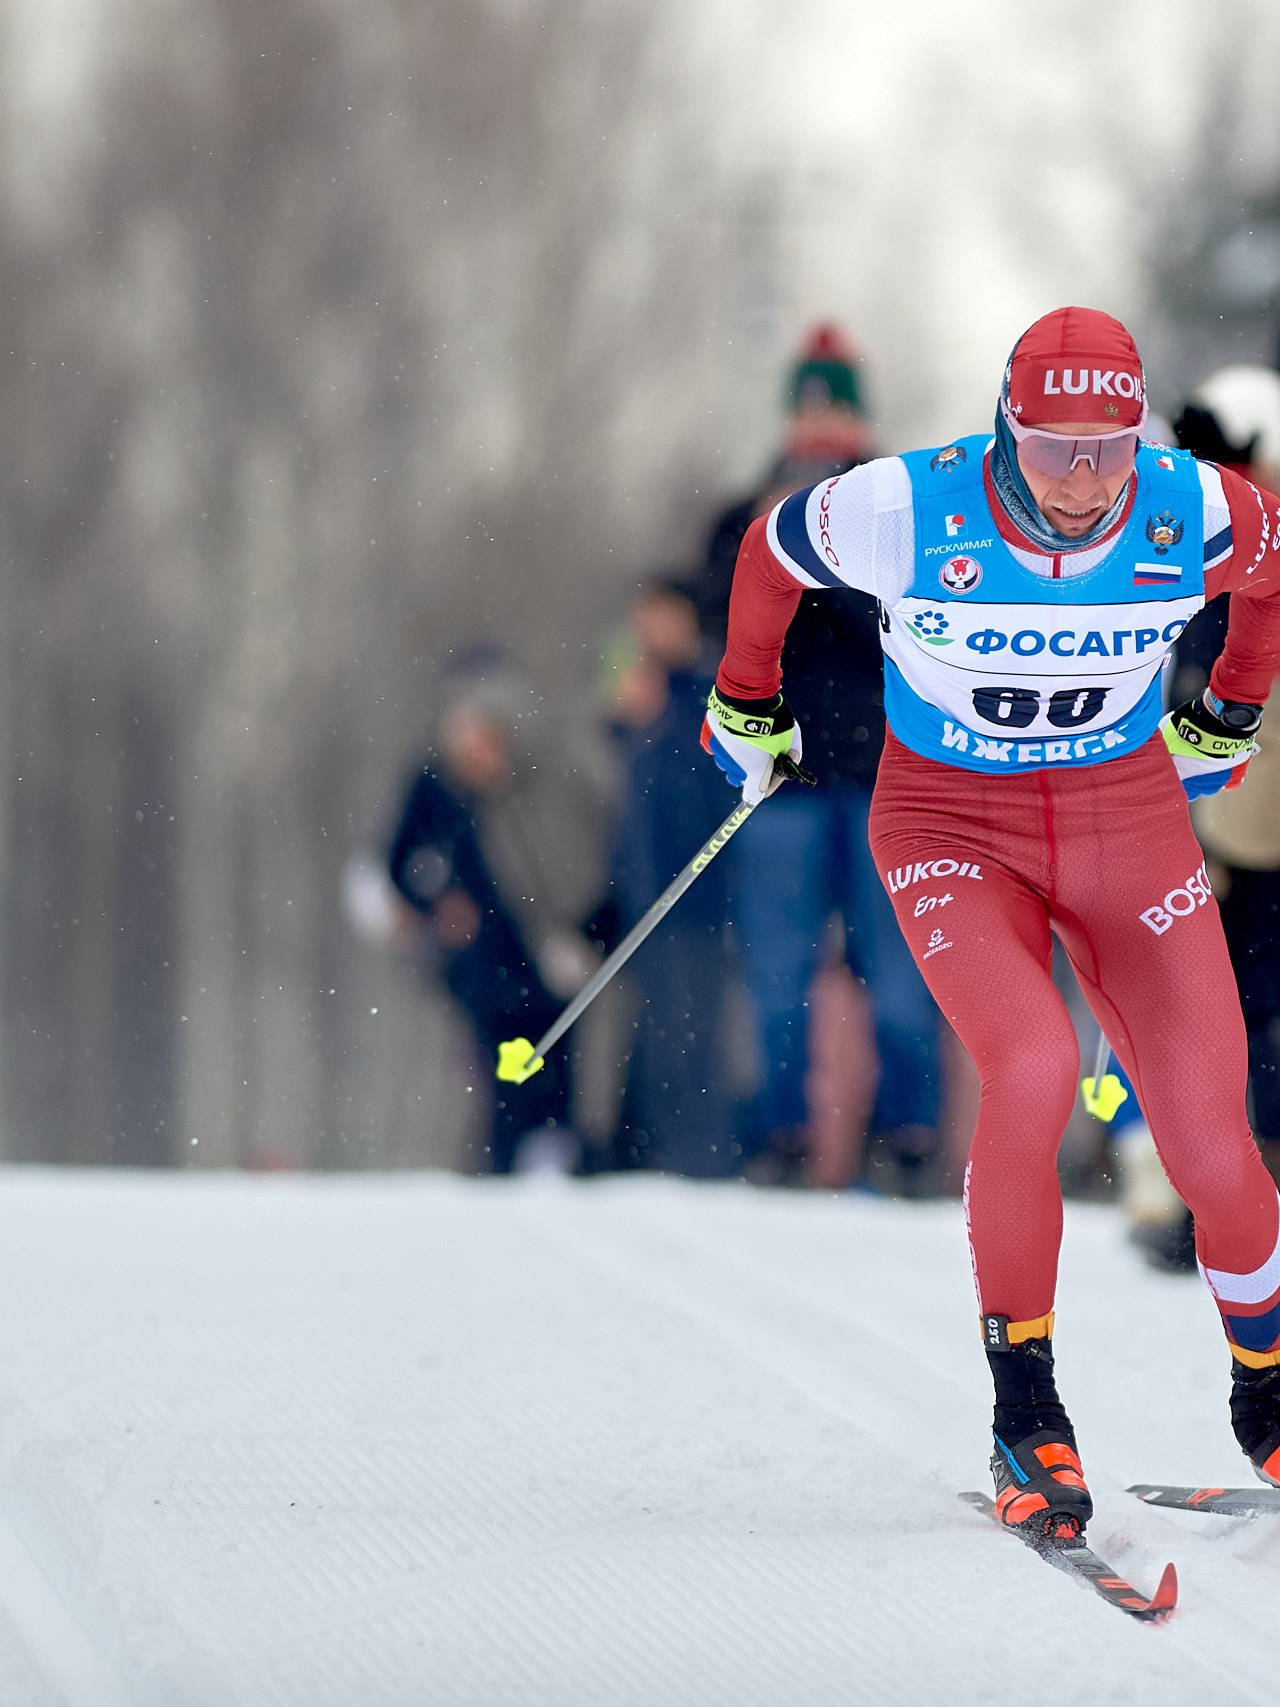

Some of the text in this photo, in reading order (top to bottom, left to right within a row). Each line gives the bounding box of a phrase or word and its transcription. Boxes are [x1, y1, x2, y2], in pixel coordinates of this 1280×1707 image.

[925, 538, 994, 557] РУСКЛИМАТ
[965, 619, 1189, 657] ФОСАГРО
[887, 858, 984, 895] LUKOIL
[914, 893, 954, 918] En+
